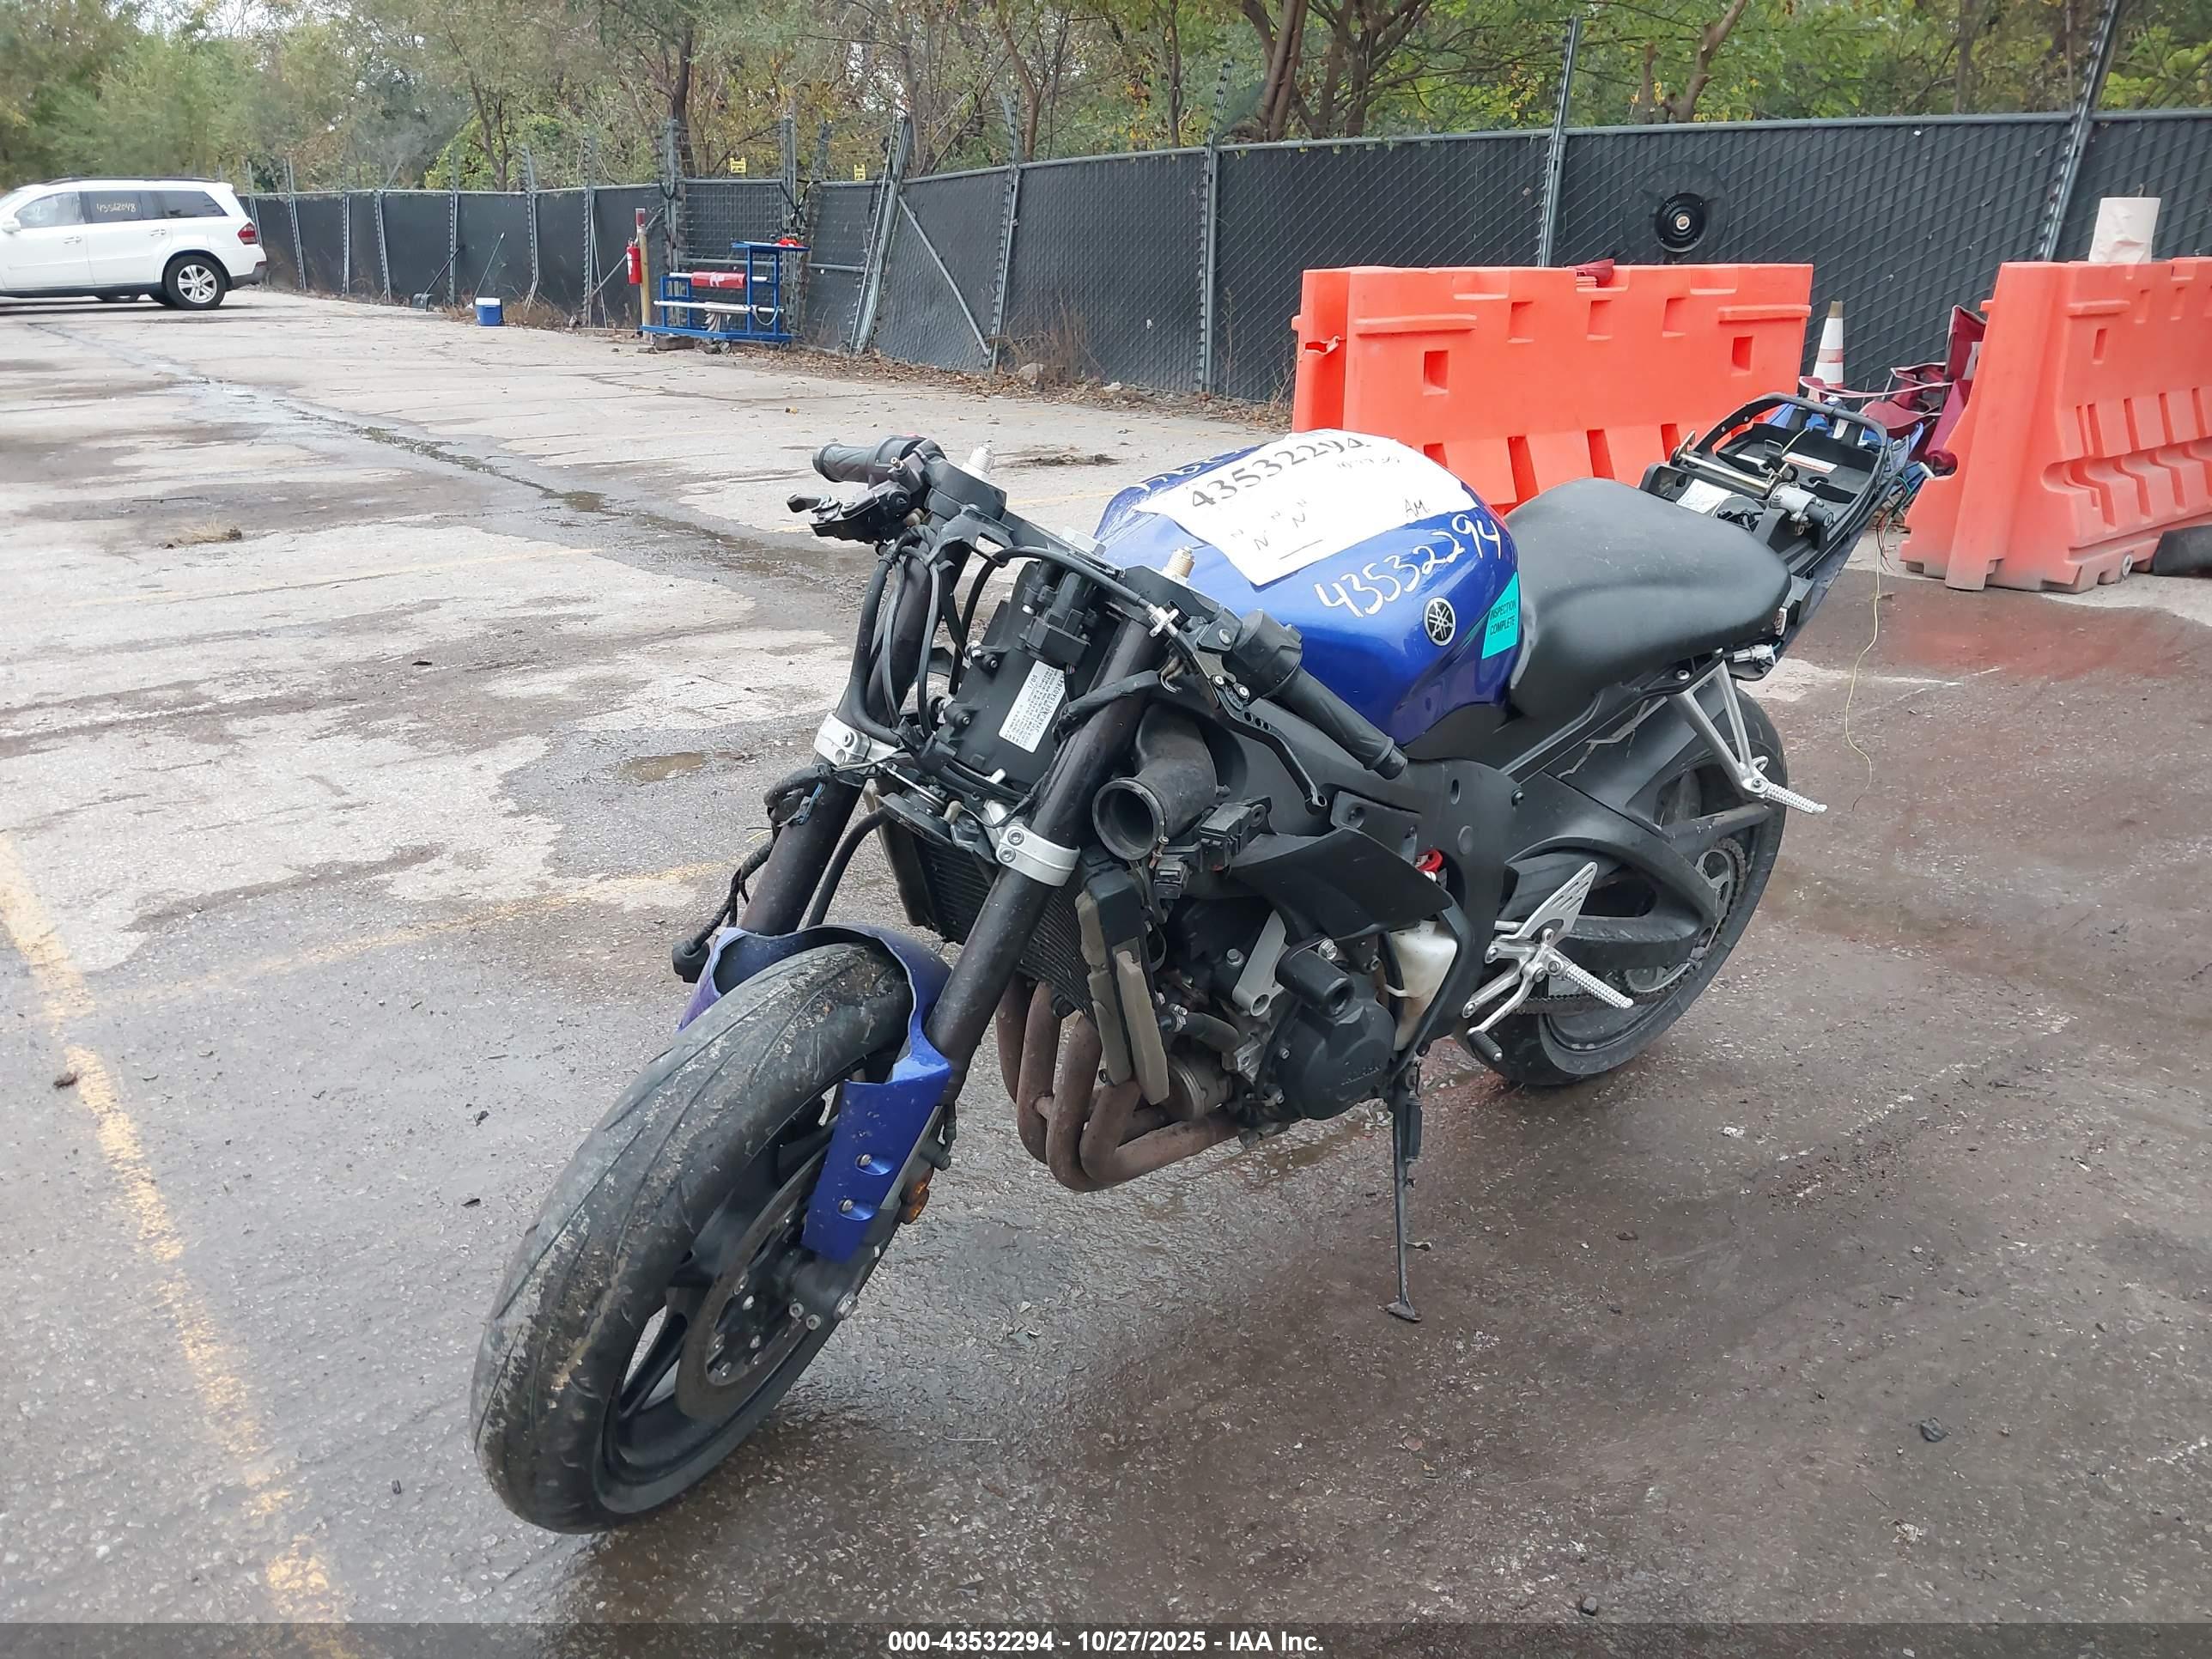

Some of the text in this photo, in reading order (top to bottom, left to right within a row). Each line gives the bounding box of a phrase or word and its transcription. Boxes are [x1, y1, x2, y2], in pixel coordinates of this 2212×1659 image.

[1313, 514, 1502, 618] 43532294
[1491, 599, 1517, 618] INSPECTION
[1490, 615, 1516, 635] COMPLETE
